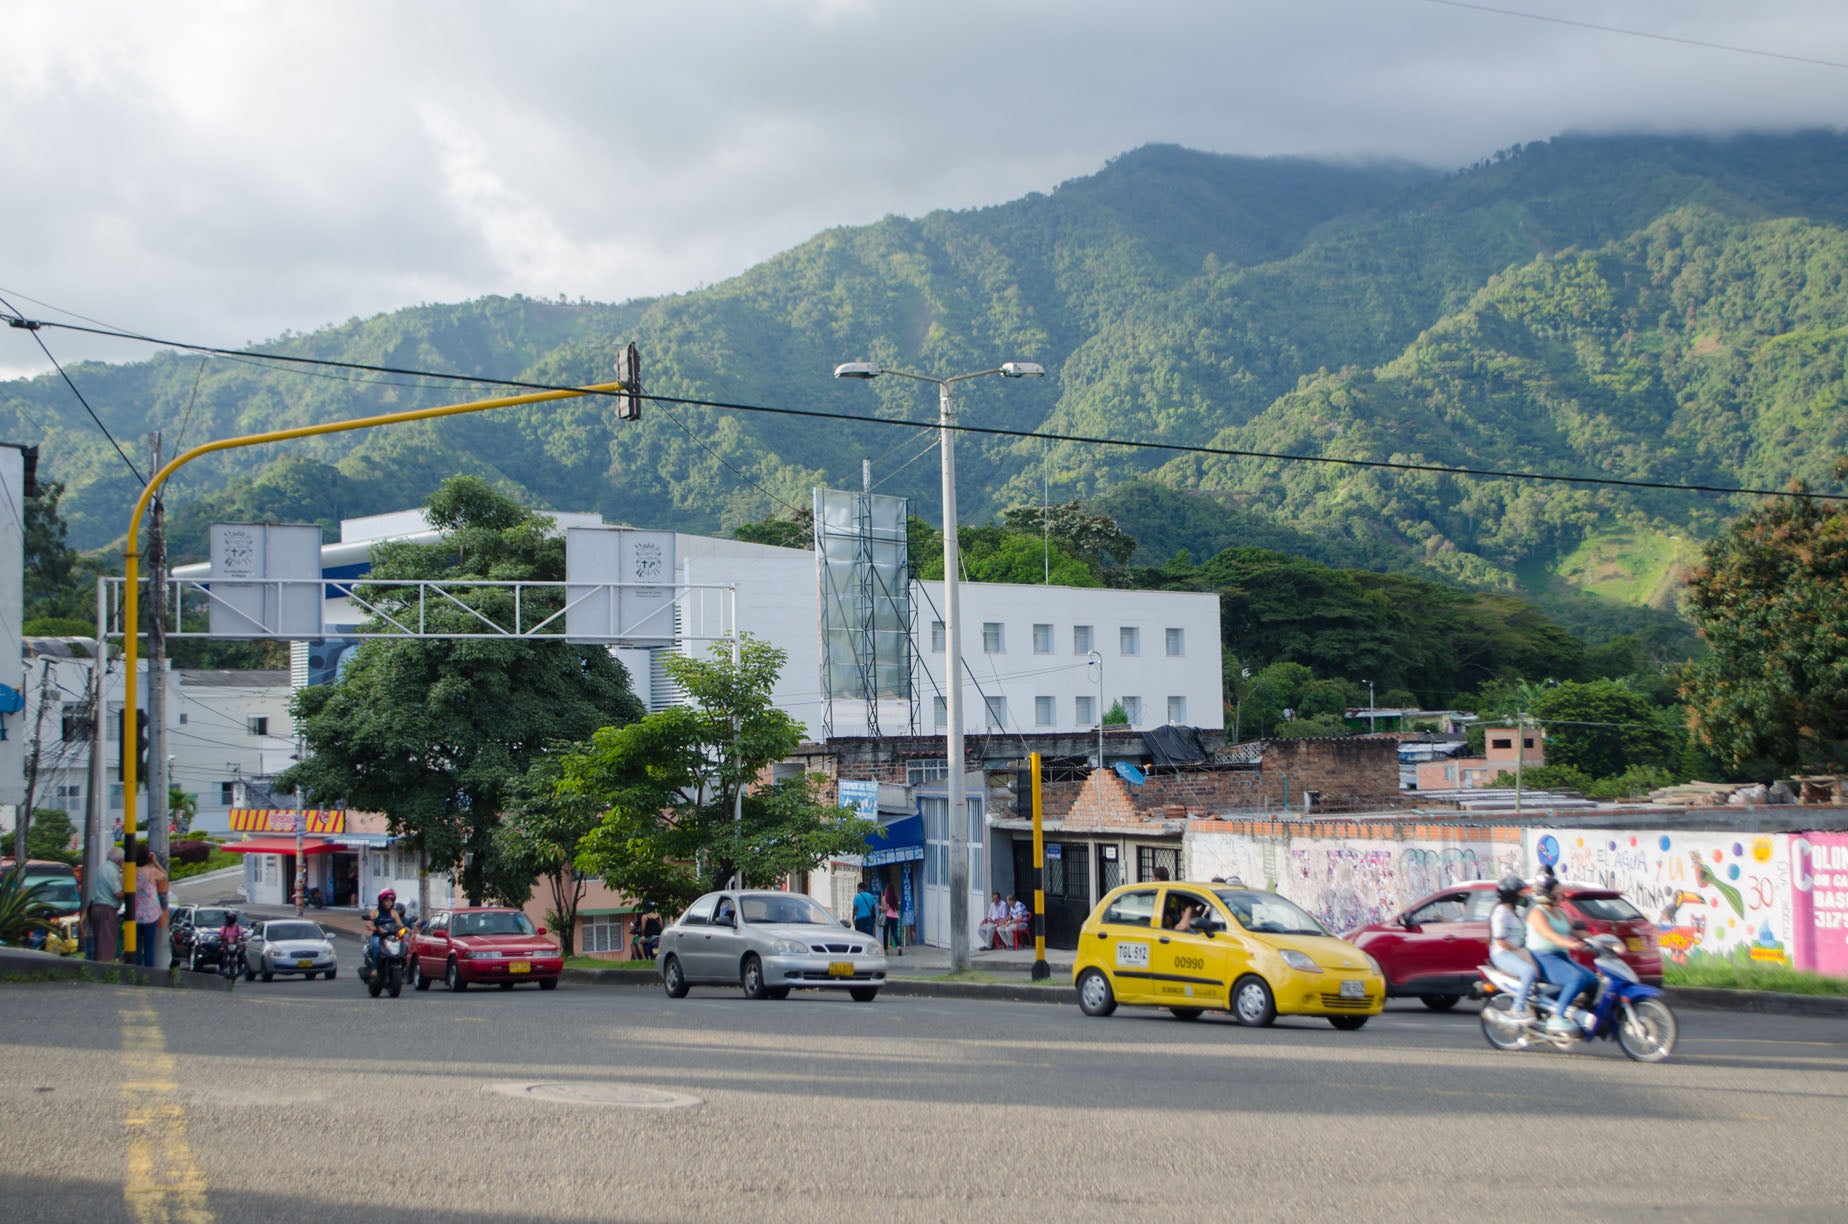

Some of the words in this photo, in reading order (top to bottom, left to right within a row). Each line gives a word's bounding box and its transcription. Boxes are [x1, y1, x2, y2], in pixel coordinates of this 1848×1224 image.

[1614, 849, 1648, 873] AGUA
[1668, 855, 1686, 881] LA
[1747, 874, 1773, 910] 30
[1813, 890, 1848, 909] BAS
[1173, 955, 1204, 970] 00990
